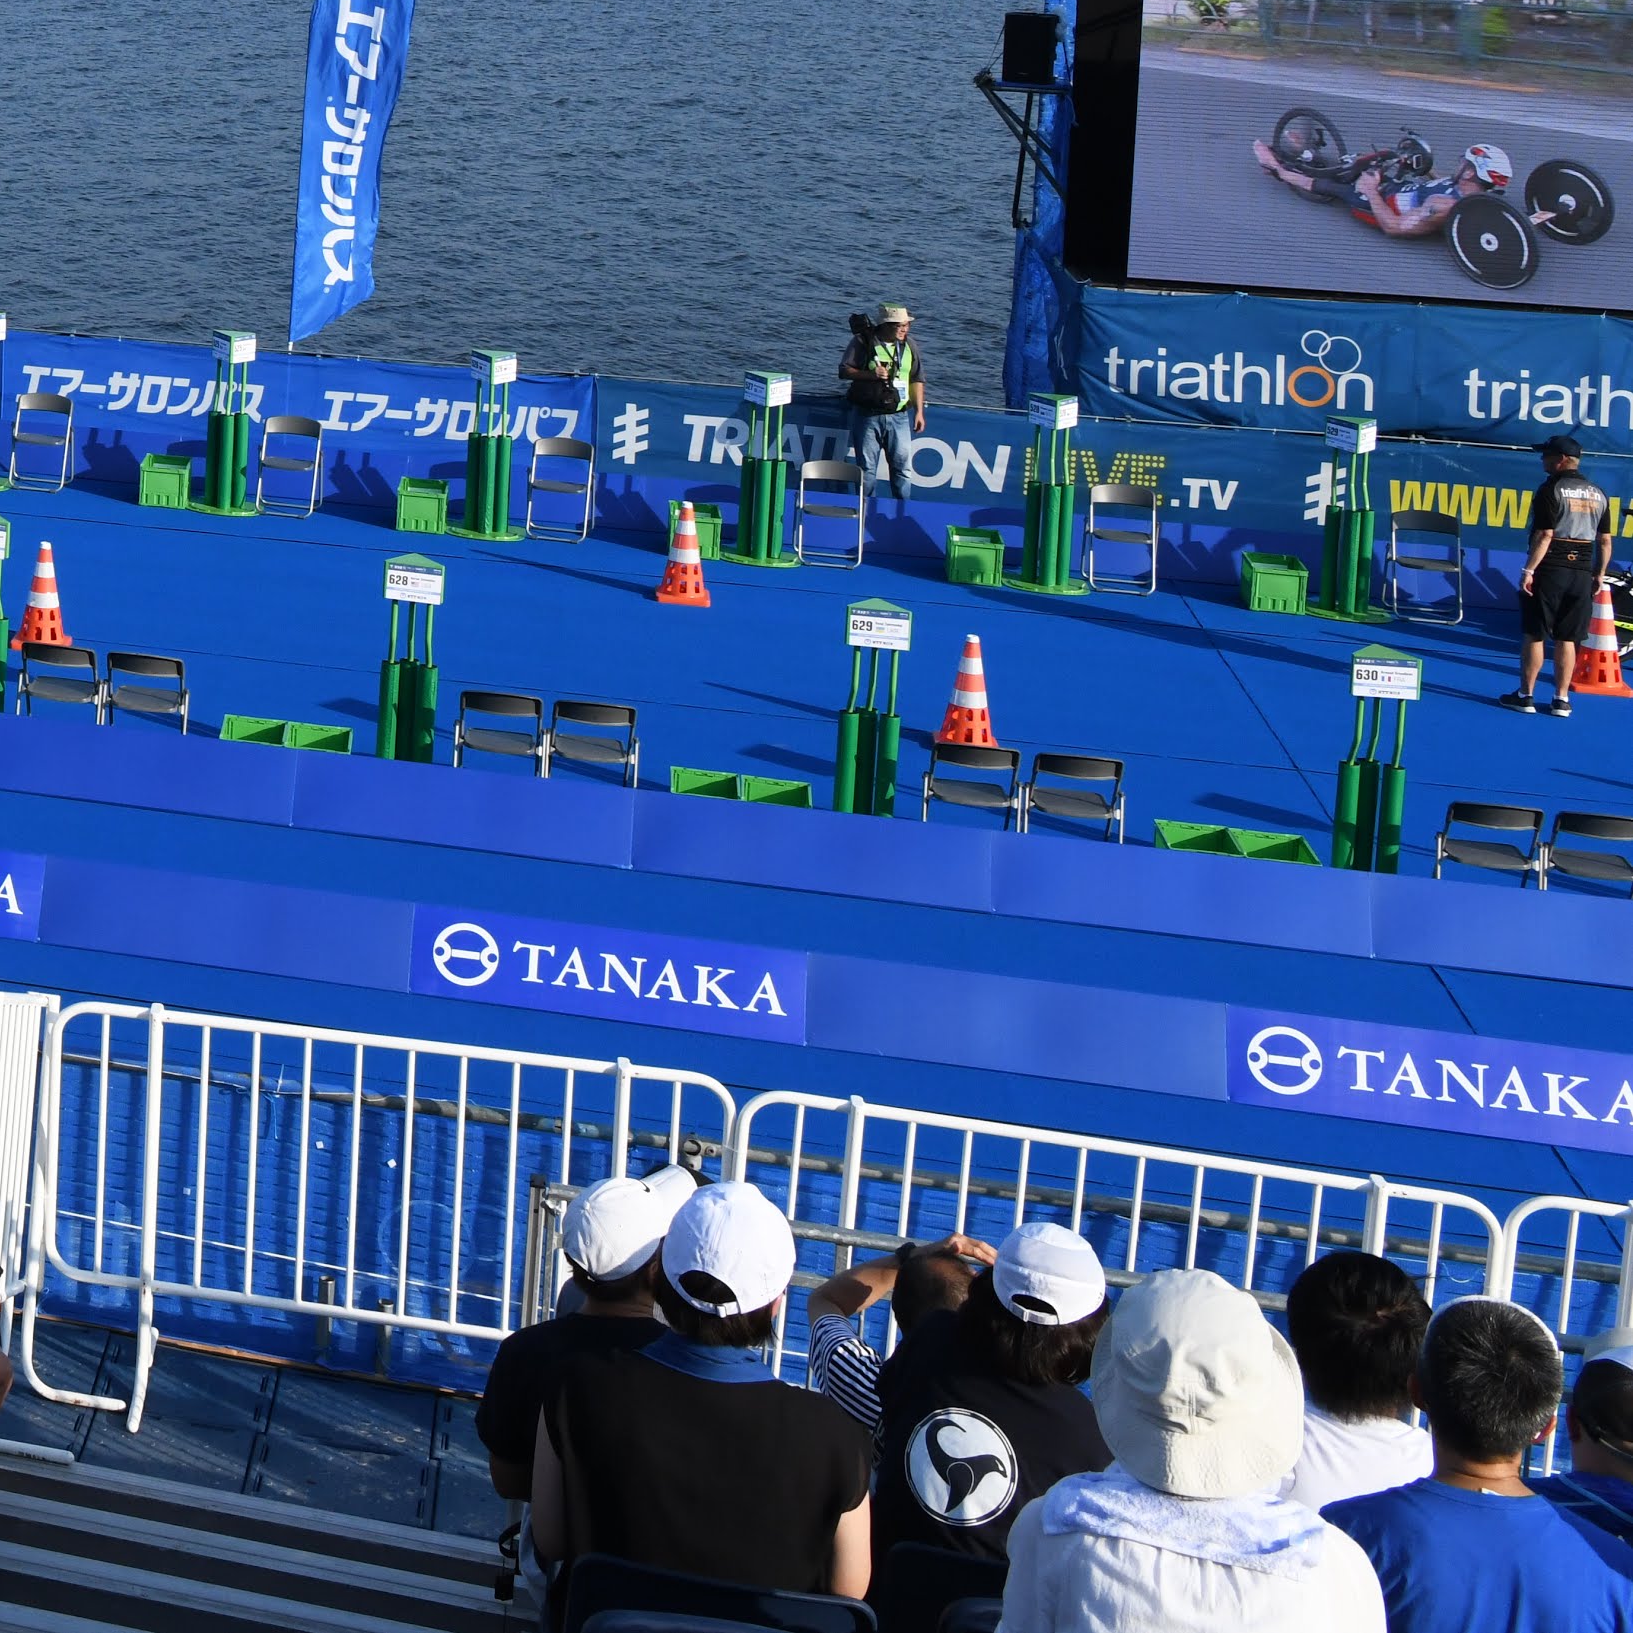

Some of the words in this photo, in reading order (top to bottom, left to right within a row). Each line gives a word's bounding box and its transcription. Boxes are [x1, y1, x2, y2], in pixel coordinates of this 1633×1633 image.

[1104, 345, 1375, 412] triathlon
[1463, 368, 1633, 430] triath
[1326, 427, 1338, 436] 529
[389, 574, 408, 586] 628
[851, 619, 873, 632] 629
[1355, 668, 1378, 681] 630
[512, 940, 788, 1017] TANAKA
